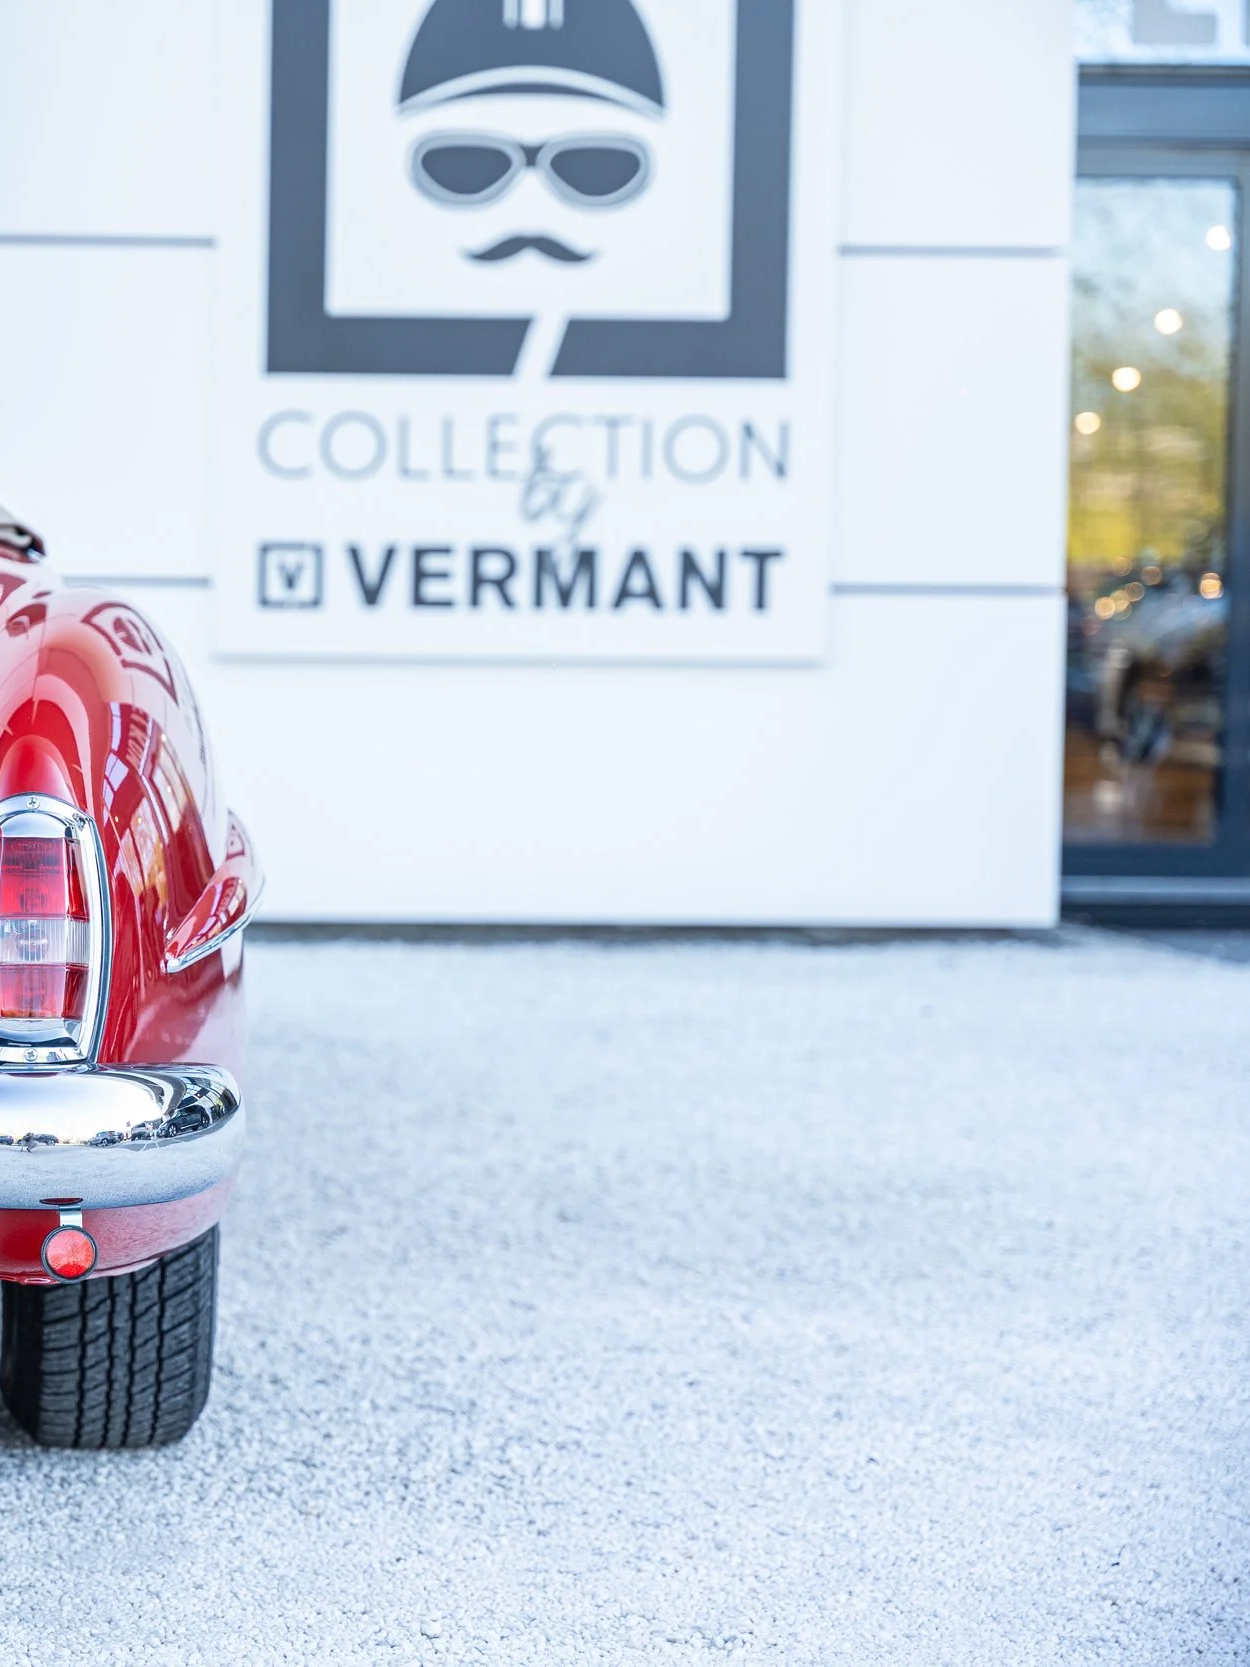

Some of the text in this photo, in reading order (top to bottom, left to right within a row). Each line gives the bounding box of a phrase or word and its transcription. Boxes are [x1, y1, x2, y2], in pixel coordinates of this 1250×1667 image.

[256, 409, 790, 484] COLLECTION
[517, 442, 604, 564] by
[346, 543, 785, 612] VERMANT
